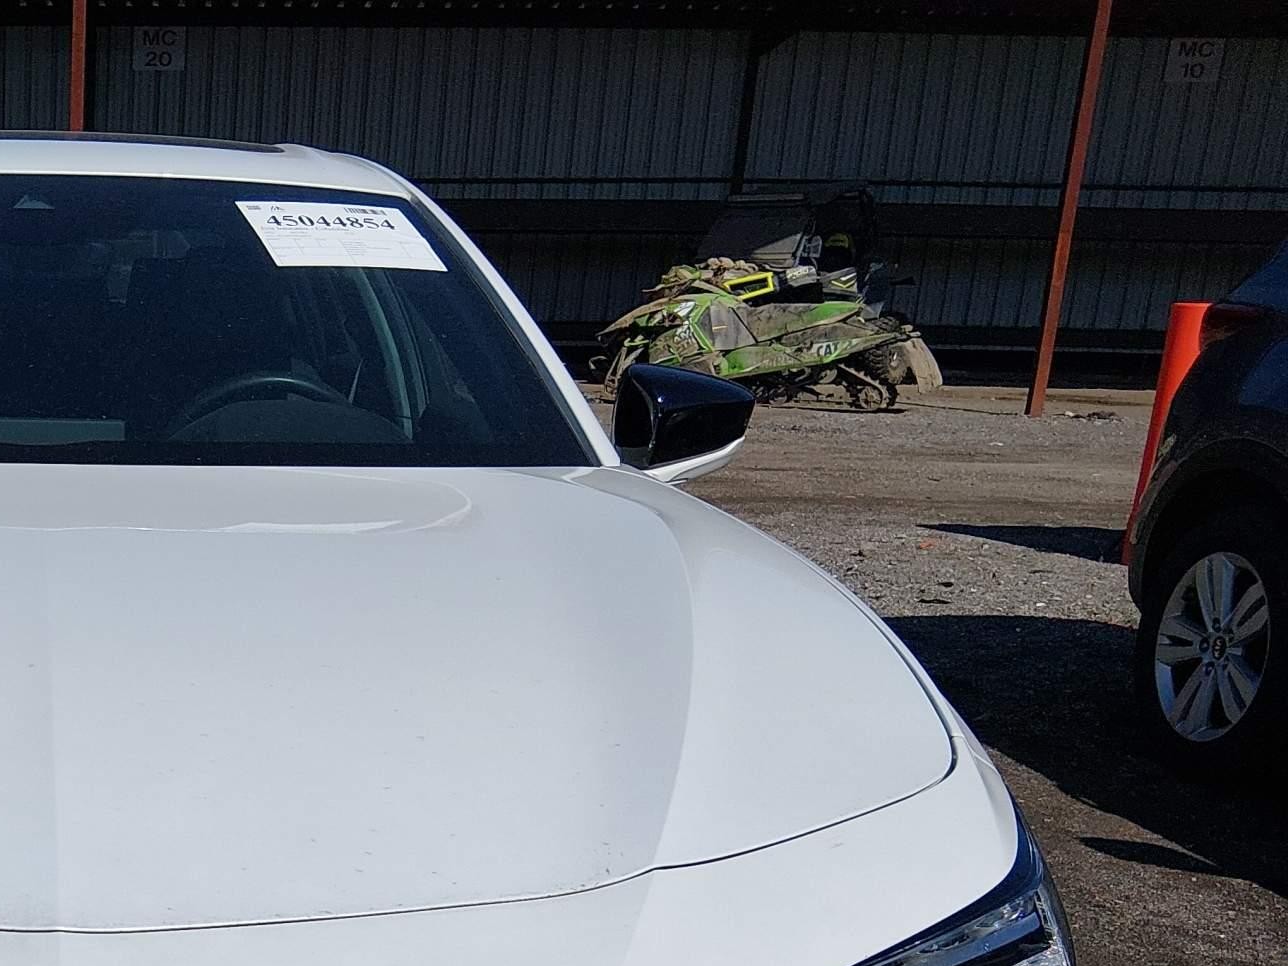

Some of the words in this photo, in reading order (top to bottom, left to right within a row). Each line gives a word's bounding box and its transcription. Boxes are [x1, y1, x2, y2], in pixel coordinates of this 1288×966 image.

[143, 30, 177, 46] MC
[1178, 41, 1215, 57] MC
[144, 51, 172, 67] 20
[1181, 63, 1204, 78] 10
[266, 215, 396, 231] 45044854
